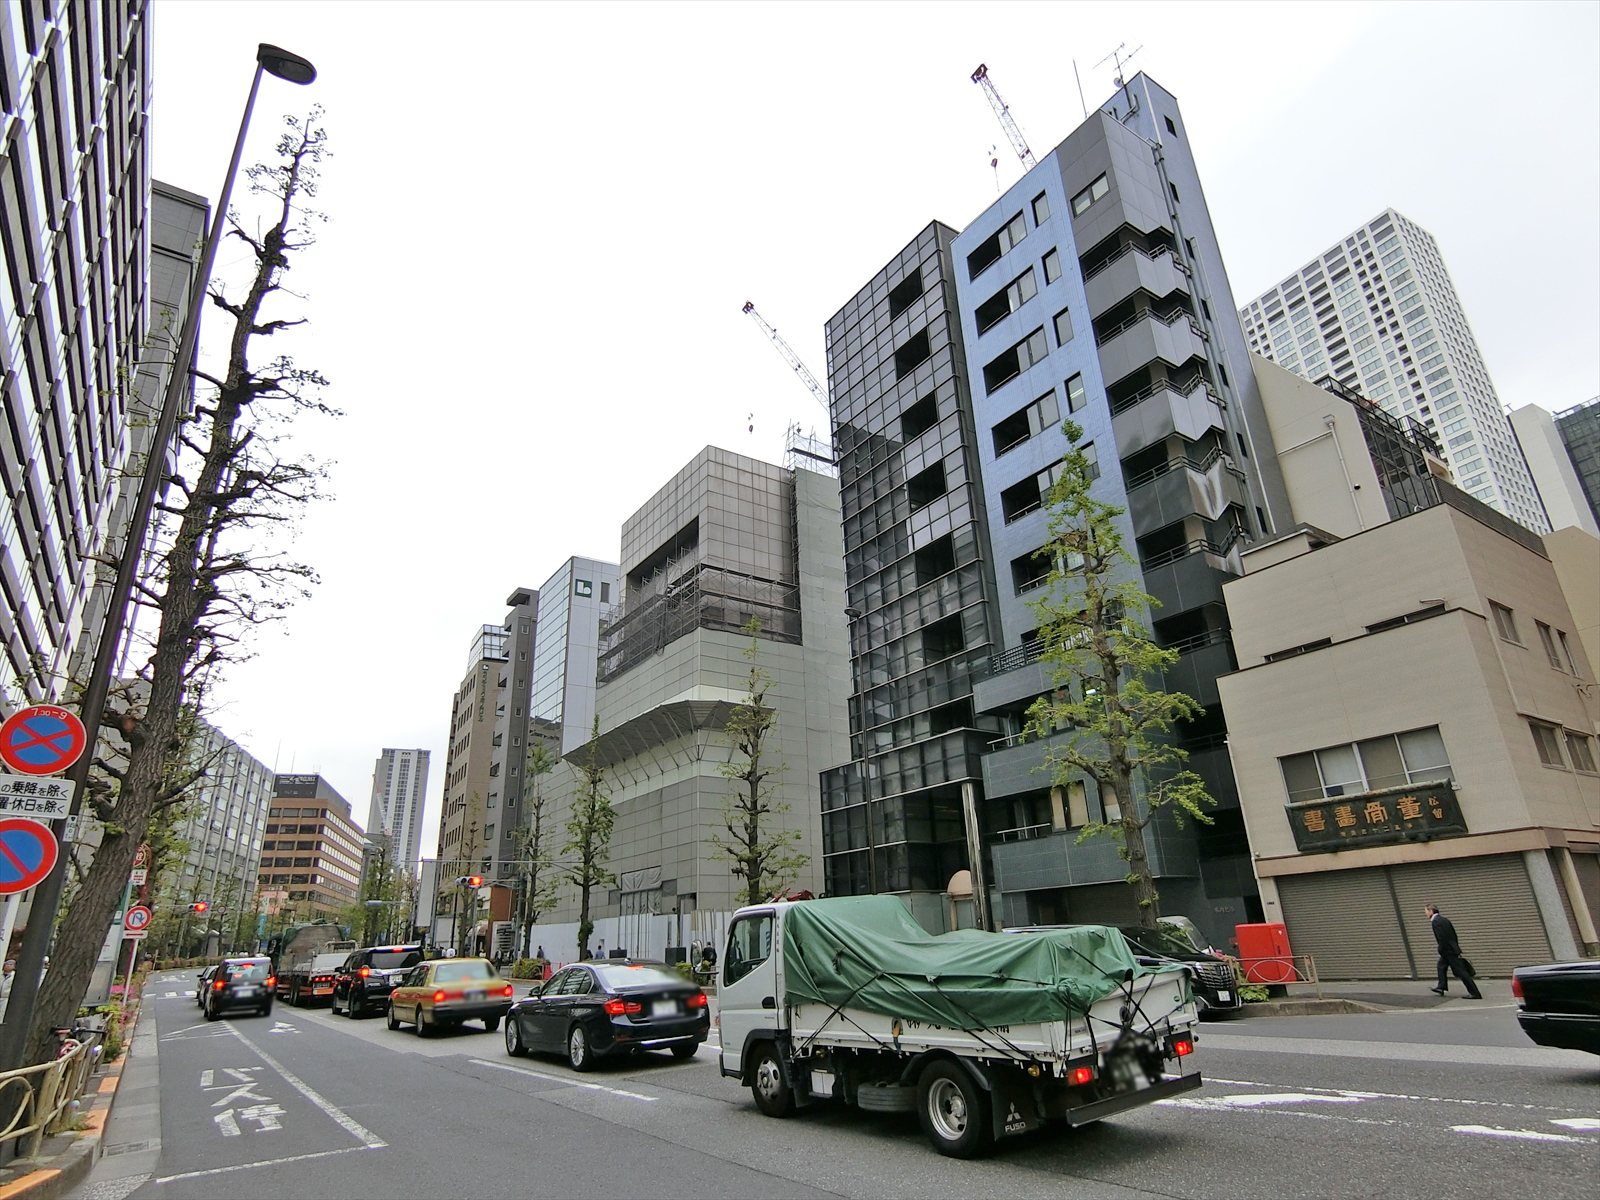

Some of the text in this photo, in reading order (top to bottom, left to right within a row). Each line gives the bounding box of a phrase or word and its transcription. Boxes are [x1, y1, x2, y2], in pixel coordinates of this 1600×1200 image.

[1, 780, 69, 798] の乗降を除く
[1005, 1121, 1026, 1133] FUSO
